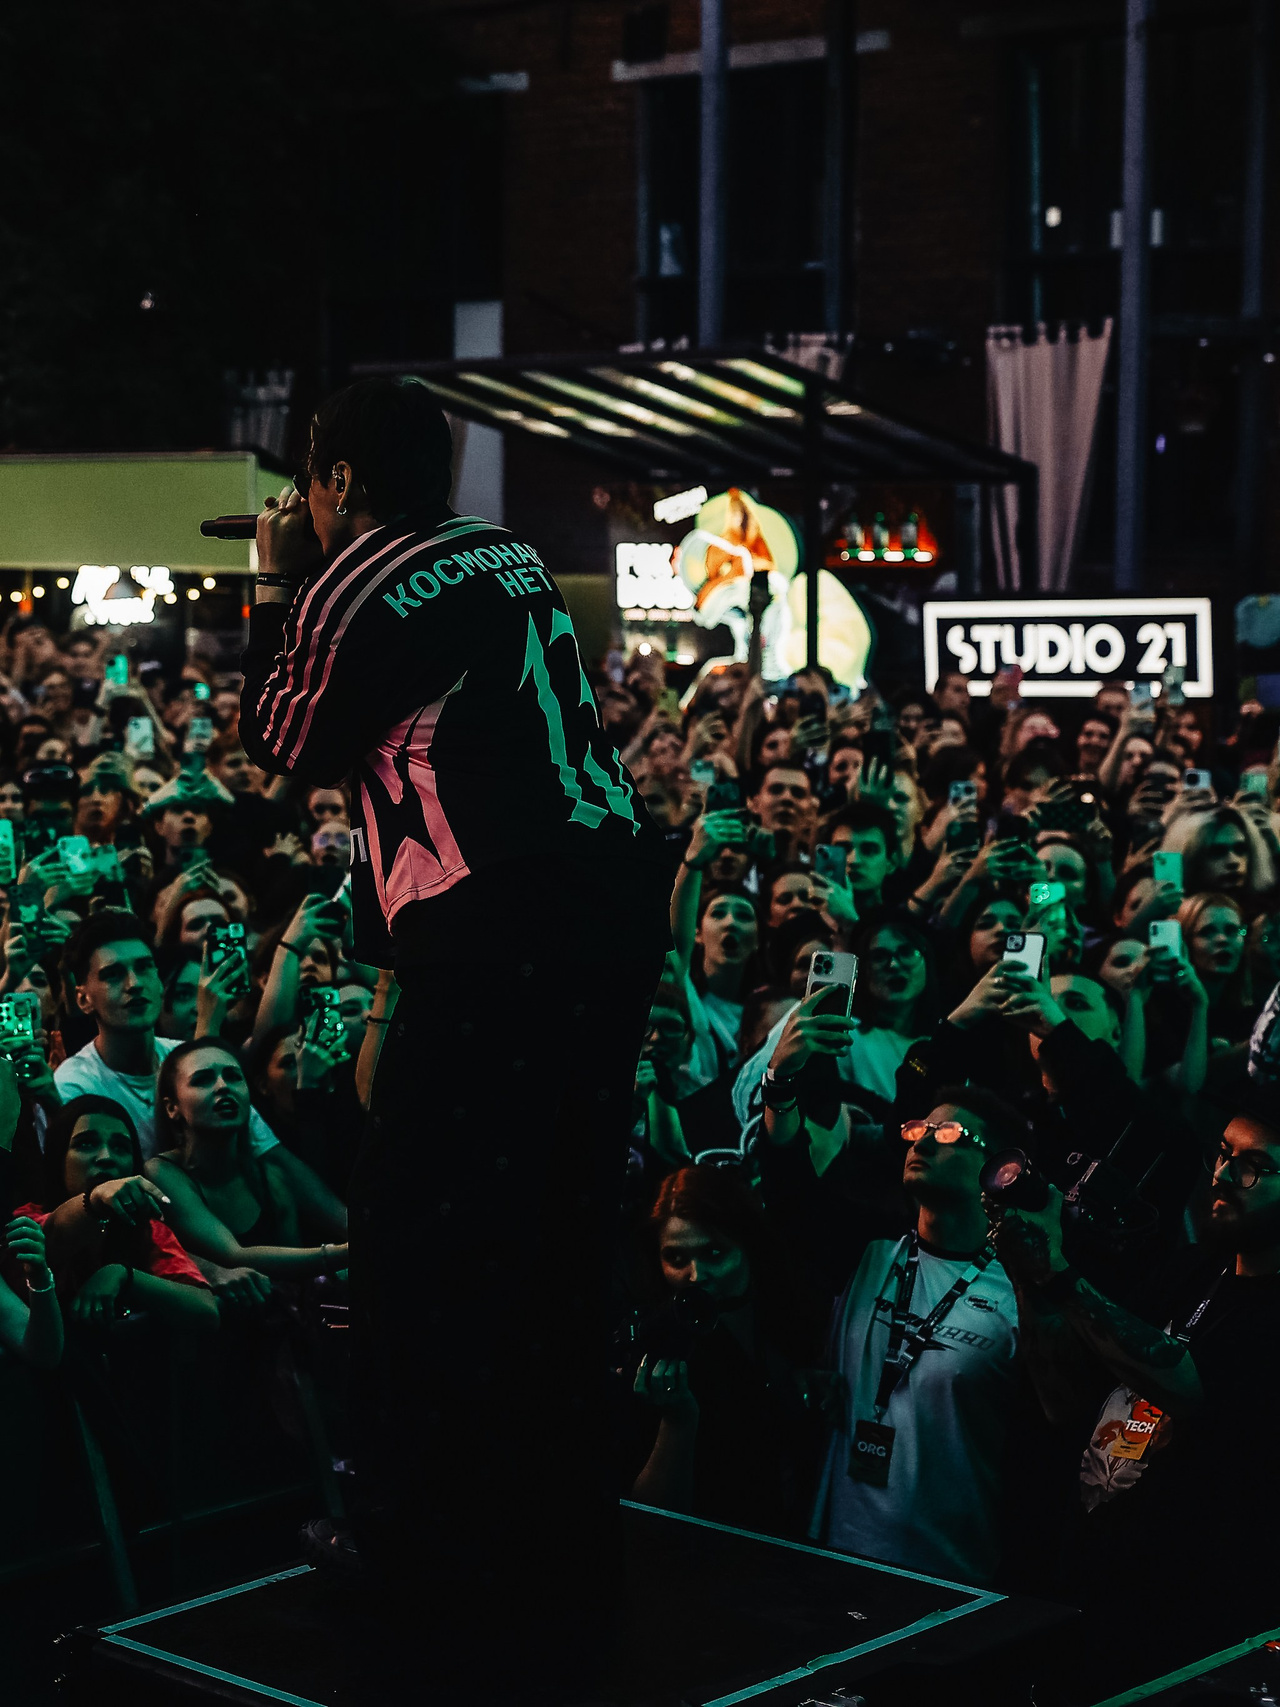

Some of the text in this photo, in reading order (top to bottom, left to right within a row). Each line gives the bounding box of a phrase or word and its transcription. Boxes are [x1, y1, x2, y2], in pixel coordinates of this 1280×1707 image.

[495, 566, 553, 598] НЕТ
[946, 622, 1187, 674] STUDIO 21
[1125, 1420, 1156, 1434] TECH
[857, 1441, 887, 1457] ORG
